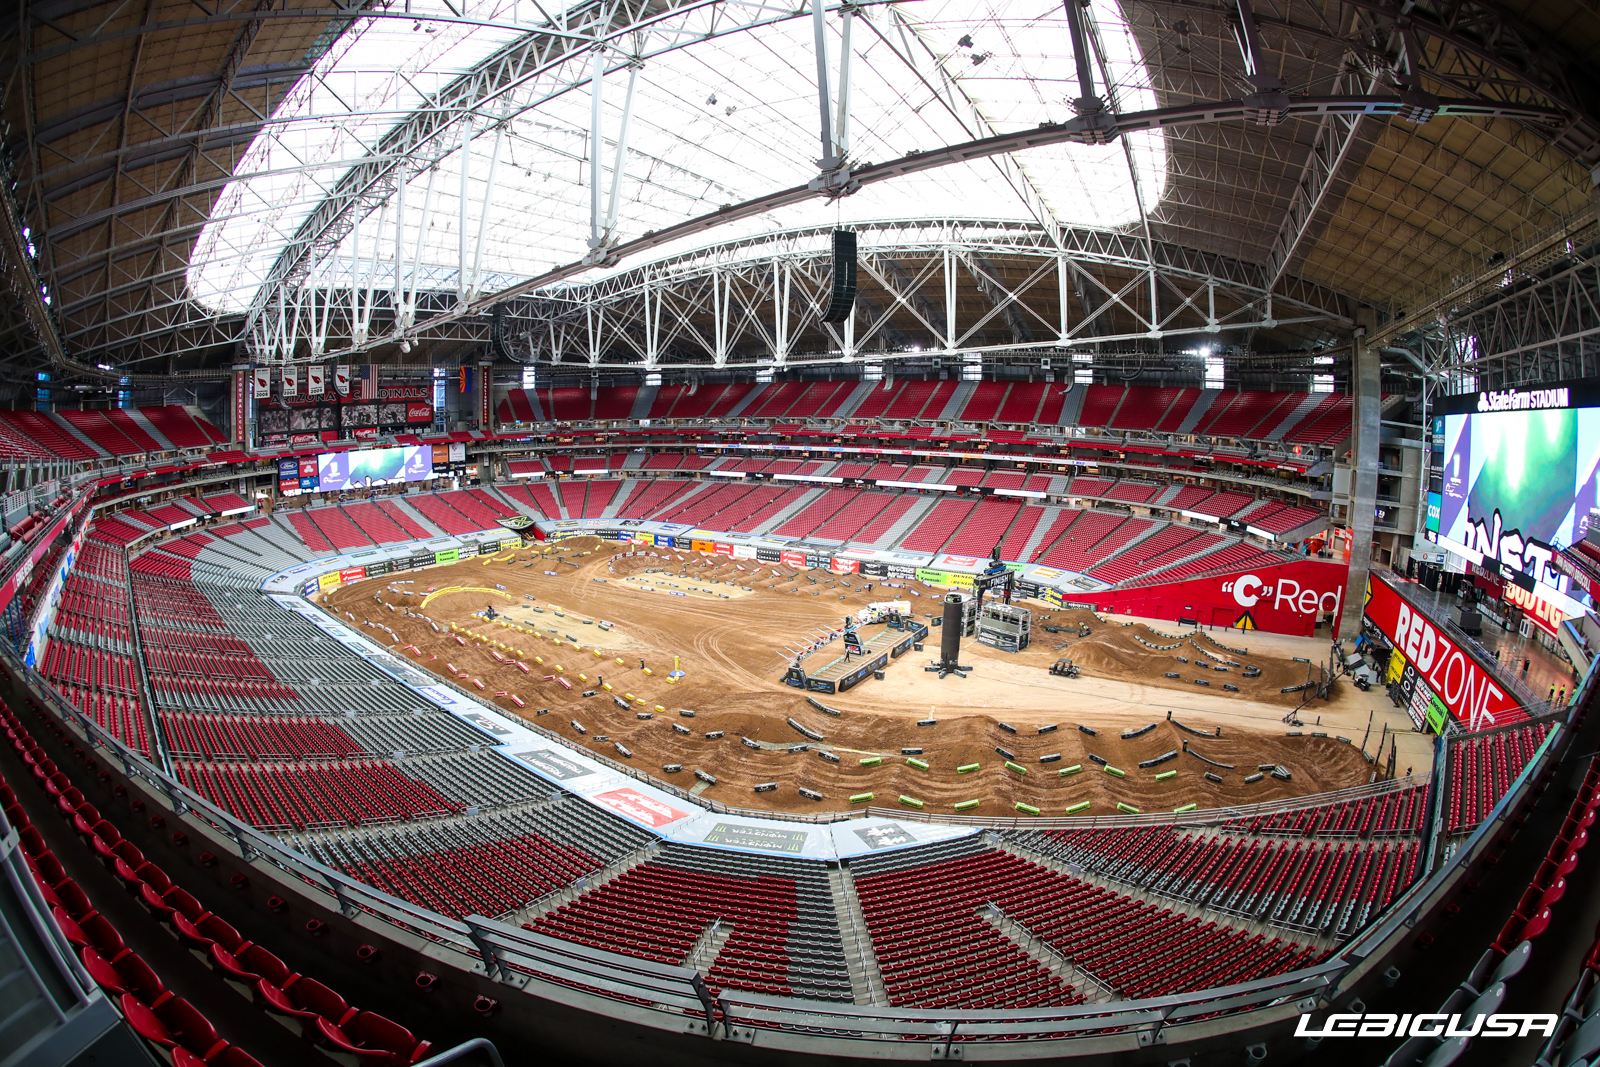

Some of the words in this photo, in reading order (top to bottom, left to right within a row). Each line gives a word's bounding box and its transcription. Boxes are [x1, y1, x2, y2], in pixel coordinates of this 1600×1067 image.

[270, 391, 337, 405] ARIZONA
[352, 387, 428, 400] CDINALS
[1530, 387, 1569, 408] STADIUM
[282, 461, 297, 469] Ford
[1427, 504, 1440, 519] COX
[322, 572, 338, 580] DUNLOP
[990, 574, 1009, 586] FINISH
[322, 579, 339, 587] DUNLOP
[1274, 578, 1342, 616] Red
[1505, 580, 1537, 611] BUD
[1394, 601, 1504, 732] REDZONE
[732, 828, 787, 839] MONSTER
[725, 838, 783, 849] MONSTER
